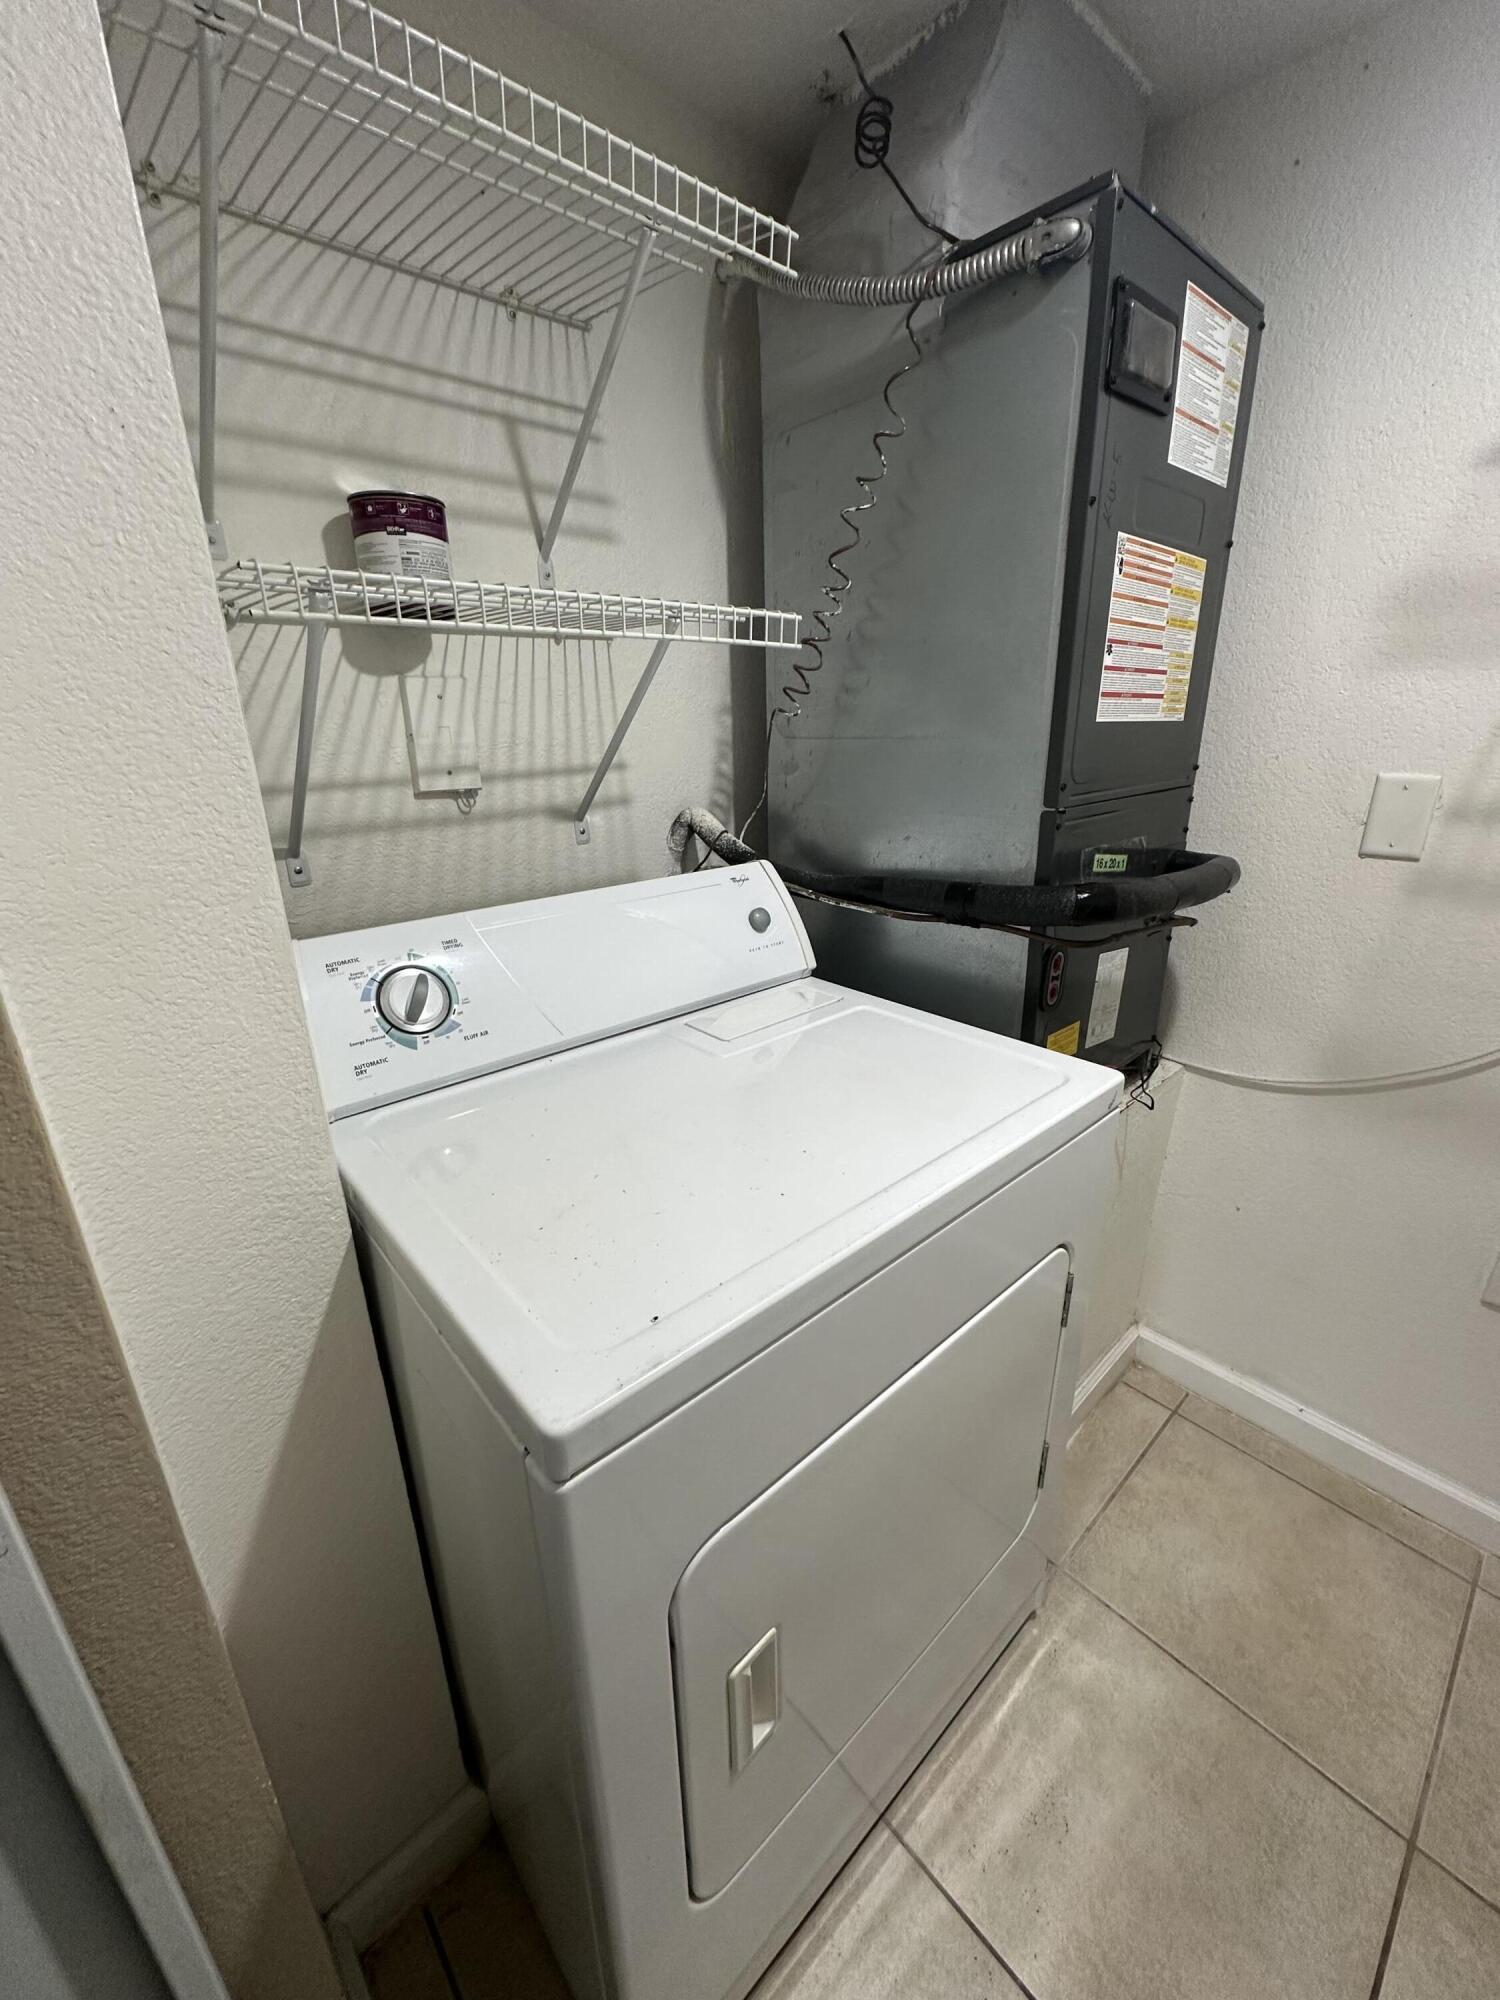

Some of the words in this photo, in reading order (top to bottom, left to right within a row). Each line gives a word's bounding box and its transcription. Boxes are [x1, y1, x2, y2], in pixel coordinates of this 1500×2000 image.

[1108, 858, 1116, 869] 20
[325, 957, 360, 969] AUTOMATIC
[463, 1033, 479, 1041] FLUFF
[354, 1057, 389, 1071] AUTOMATIC
[355, 1069, 368, 1077] DRY
